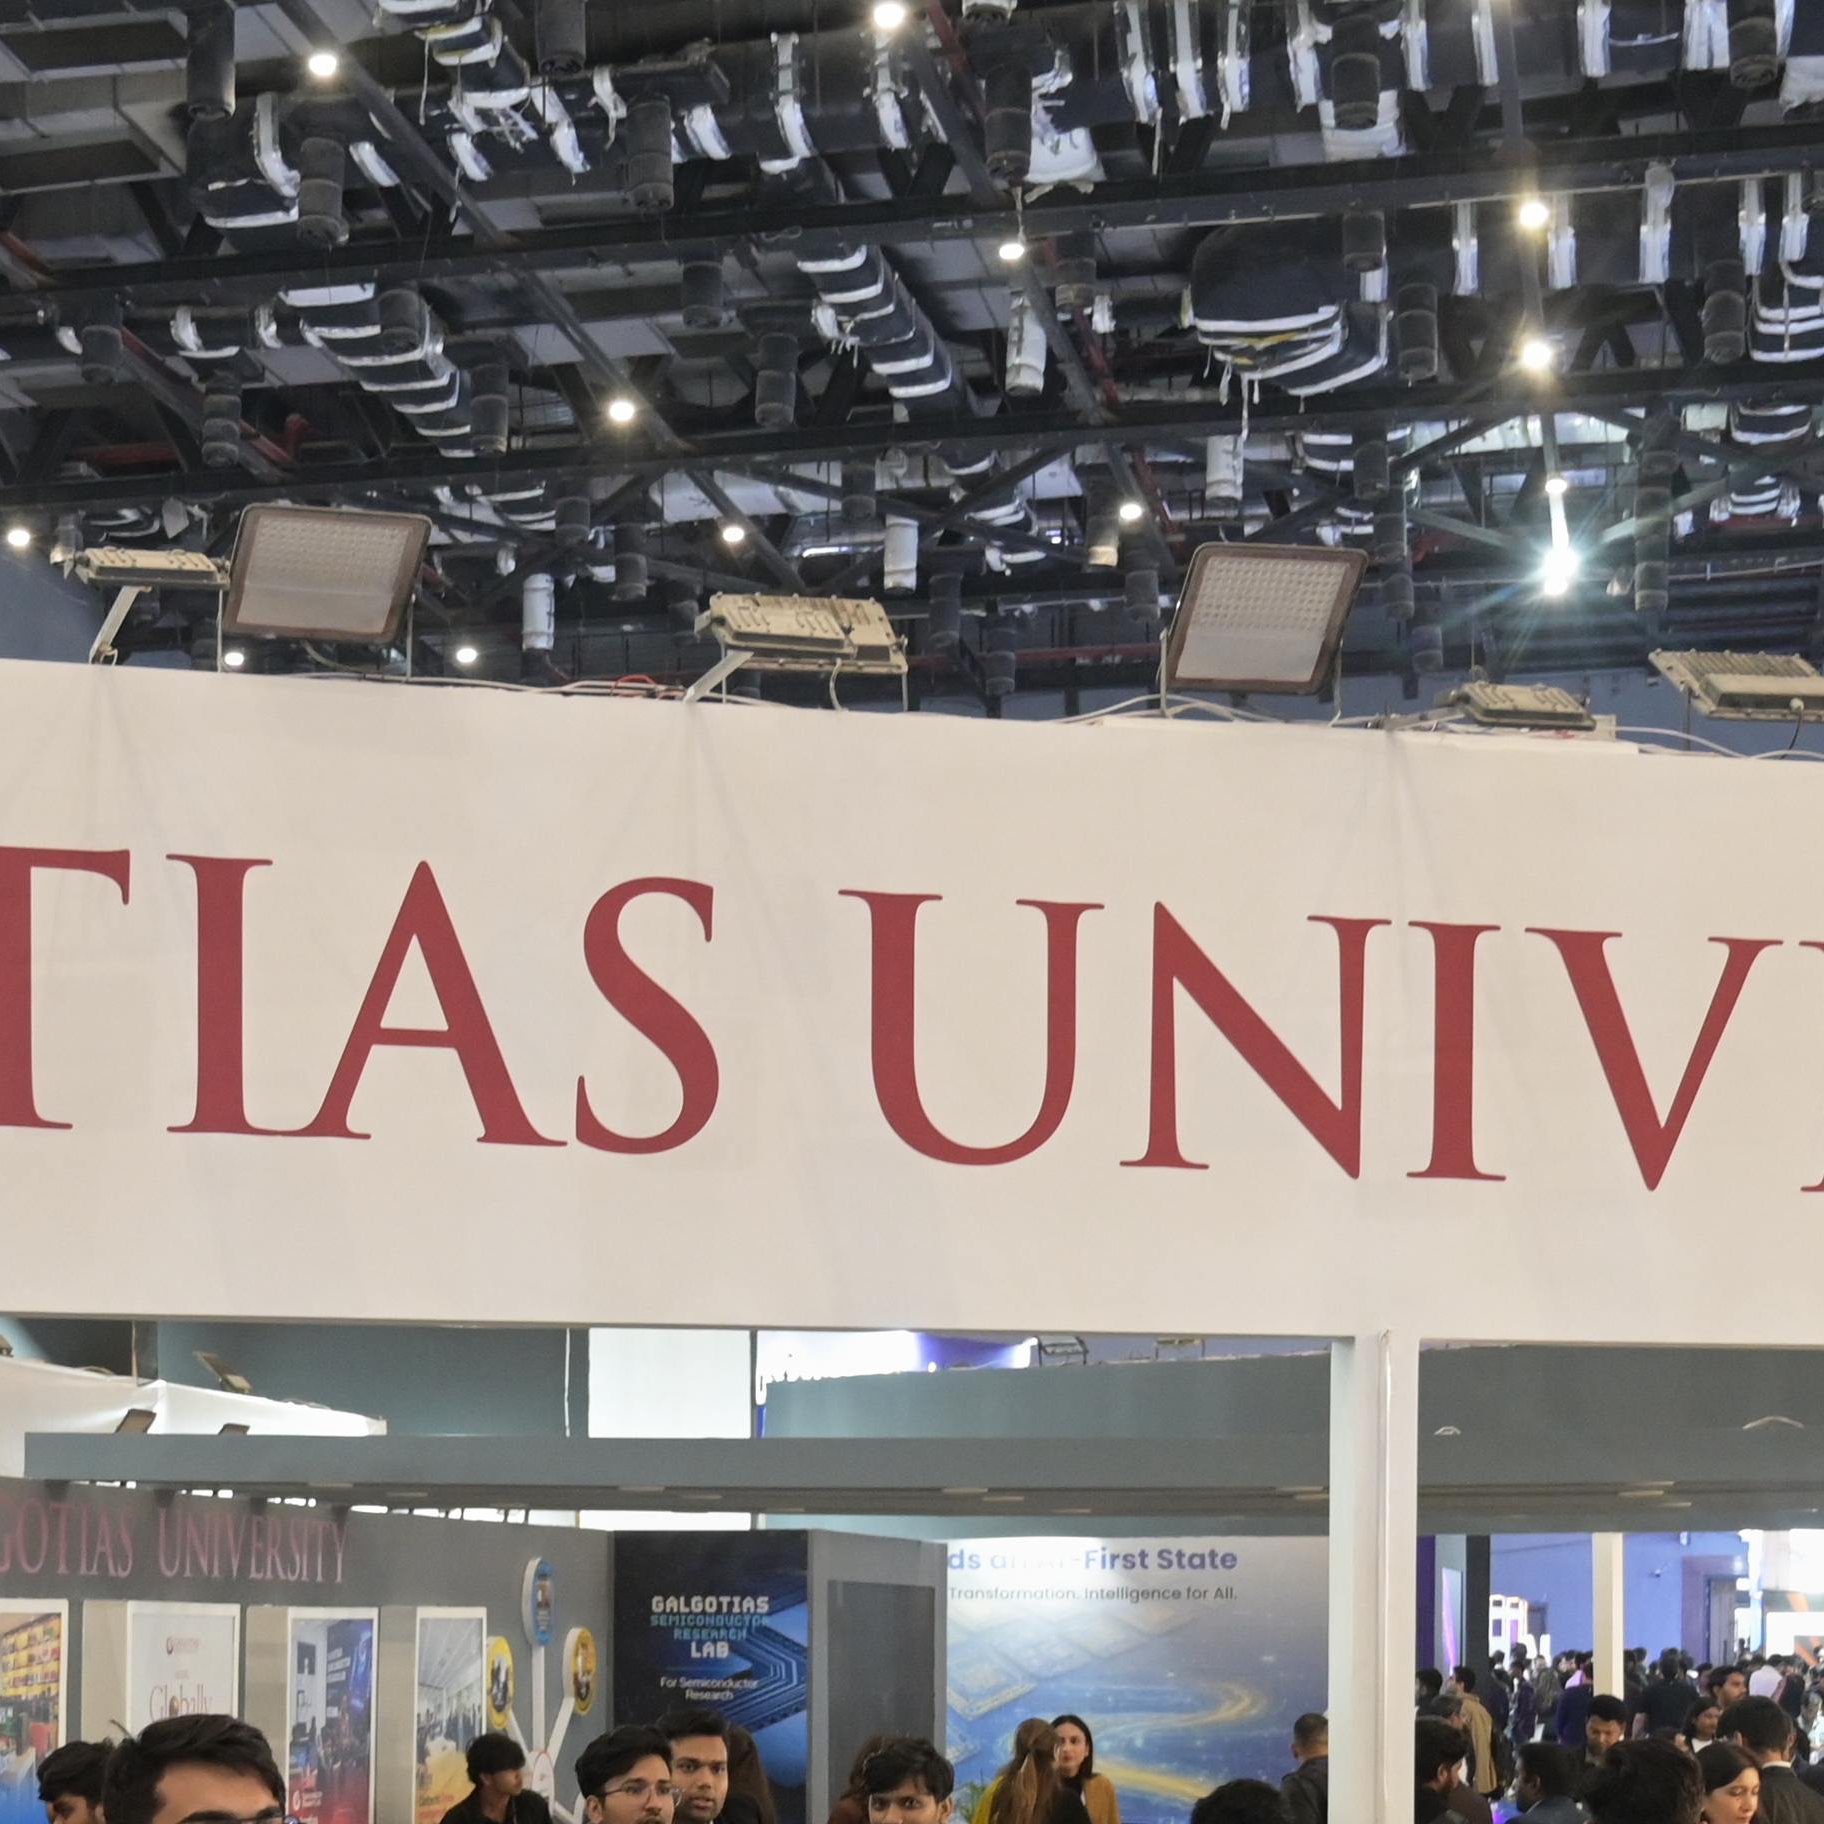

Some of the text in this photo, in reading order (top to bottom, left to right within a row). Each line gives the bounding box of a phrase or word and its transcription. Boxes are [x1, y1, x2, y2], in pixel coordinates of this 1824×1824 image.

[157, 1506, 348, 1583] UNIVERSITY
[1157, 1549, 1238, 1570] State
[1085, 1586, 1181, 1604] Intelligence
[1186, 1587, 1208, 1600] for
[651, 1596, 769, 1613] GALGOTIAS
[650, 1615, 771, 1627] SEMICONDUCTOR
[674, 1628, 747, 1641] RESEARCH
[691, 1641, 730, 1659] LAB
[660, 1677, 759, 1690] For Semiconductor
[685, 1689, 734, 1700] Research
